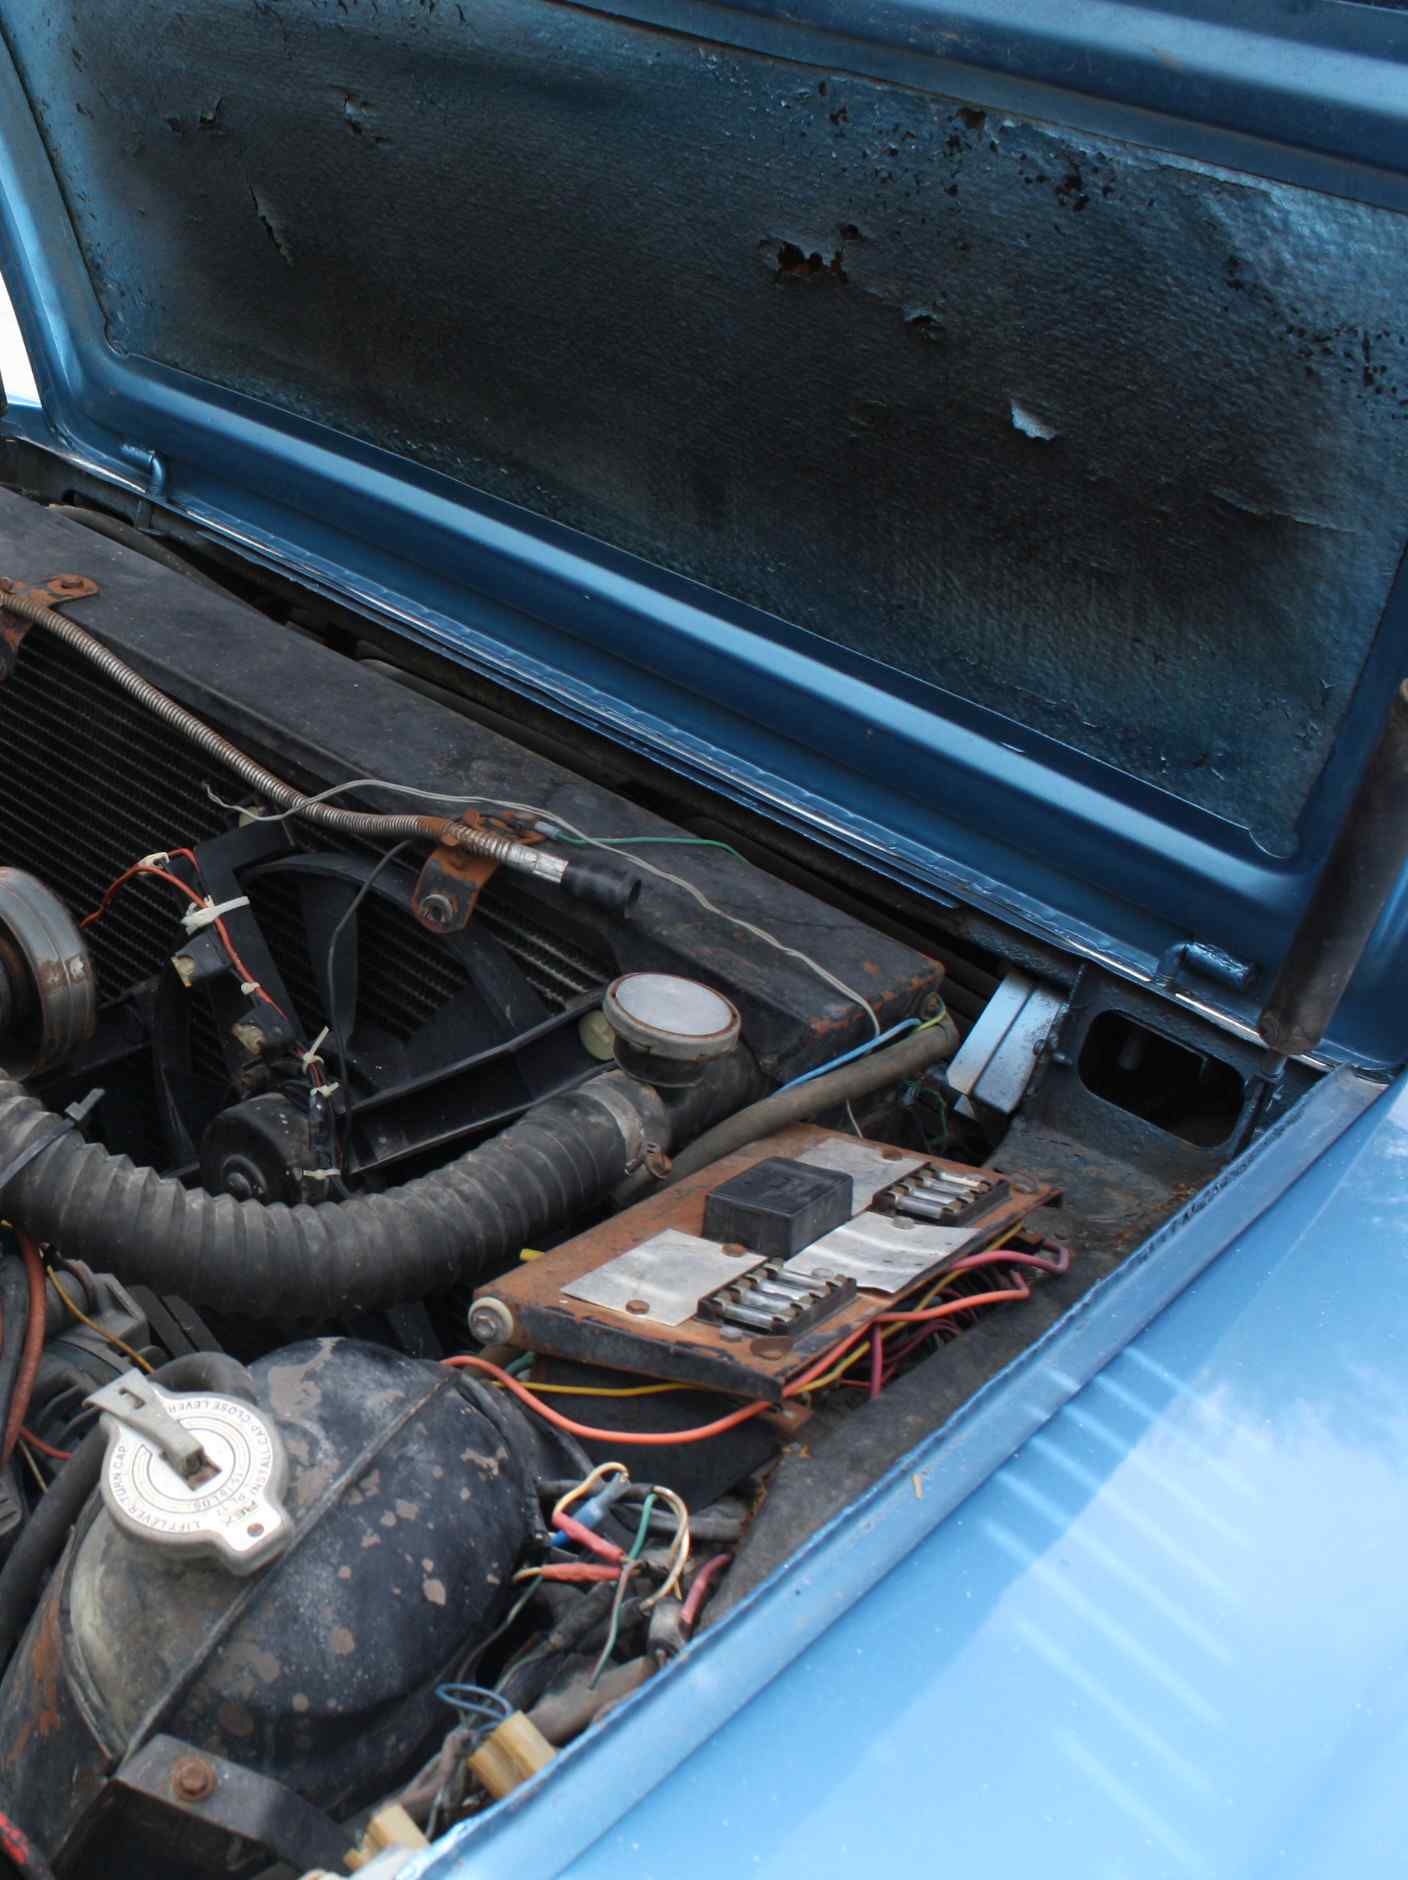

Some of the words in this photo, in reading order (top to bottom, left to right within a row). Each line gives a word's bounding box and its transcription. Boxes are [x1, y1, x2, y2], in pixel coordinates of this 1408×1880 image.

[167, 1400, 209, 1414] LEVER
[214, 1400, 250, 1423] CLOSE
[250, 1424, 269, 1446] CAP
[112, 1445, 128, 1470] CAP
[111, 1471, 128, 1504] TURN
[128, 1504, 167, 1530] LEVER
[169, 1519, 201, 1532] LIFT
